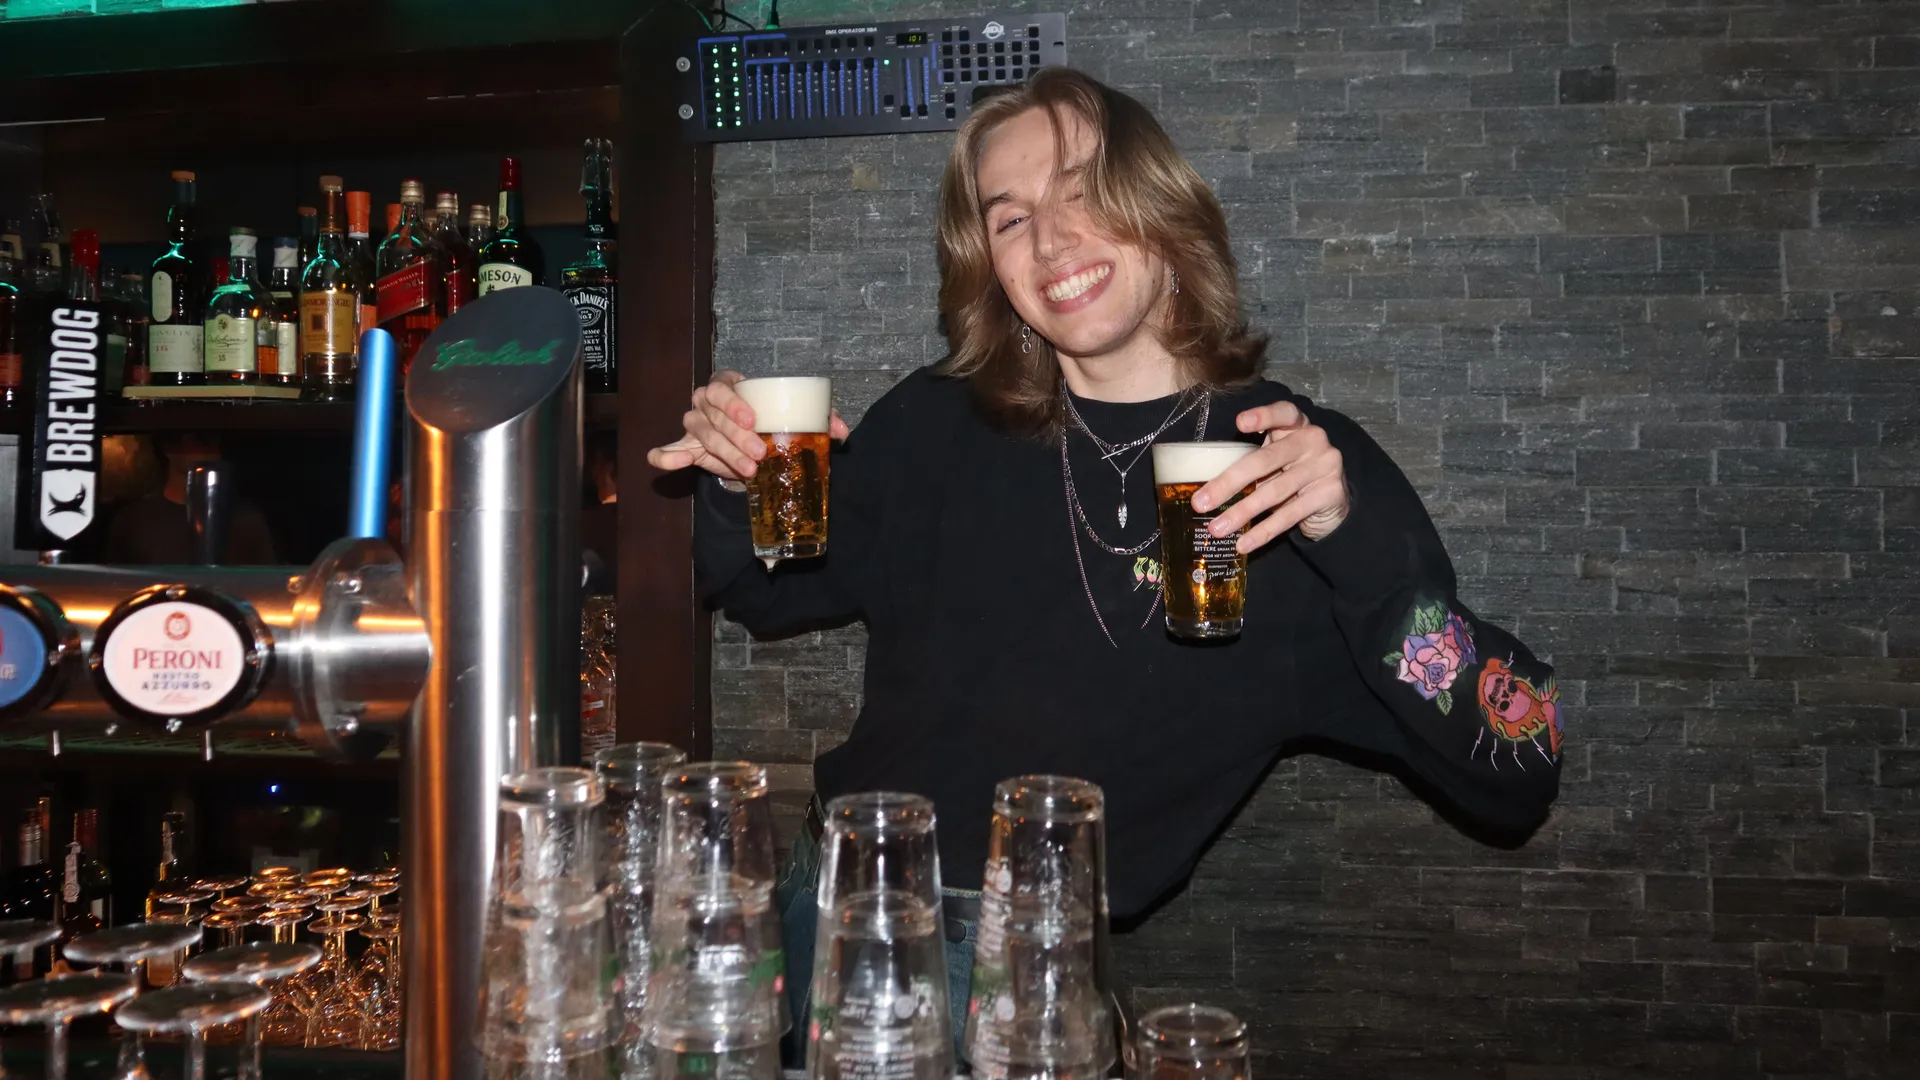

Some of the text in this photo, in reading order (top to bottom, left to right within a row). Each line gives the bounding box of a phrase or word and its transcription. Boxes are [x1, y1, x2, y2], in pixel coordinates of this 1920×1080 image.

[478, 270, 522, 286] MESON
[431, 339, 562, 371] Grolsch
[46, 308, 99, 463] BREWDOG
[133, 647, 222, 669] PERONI
[142, 681, 211, 690] AZZURRO
